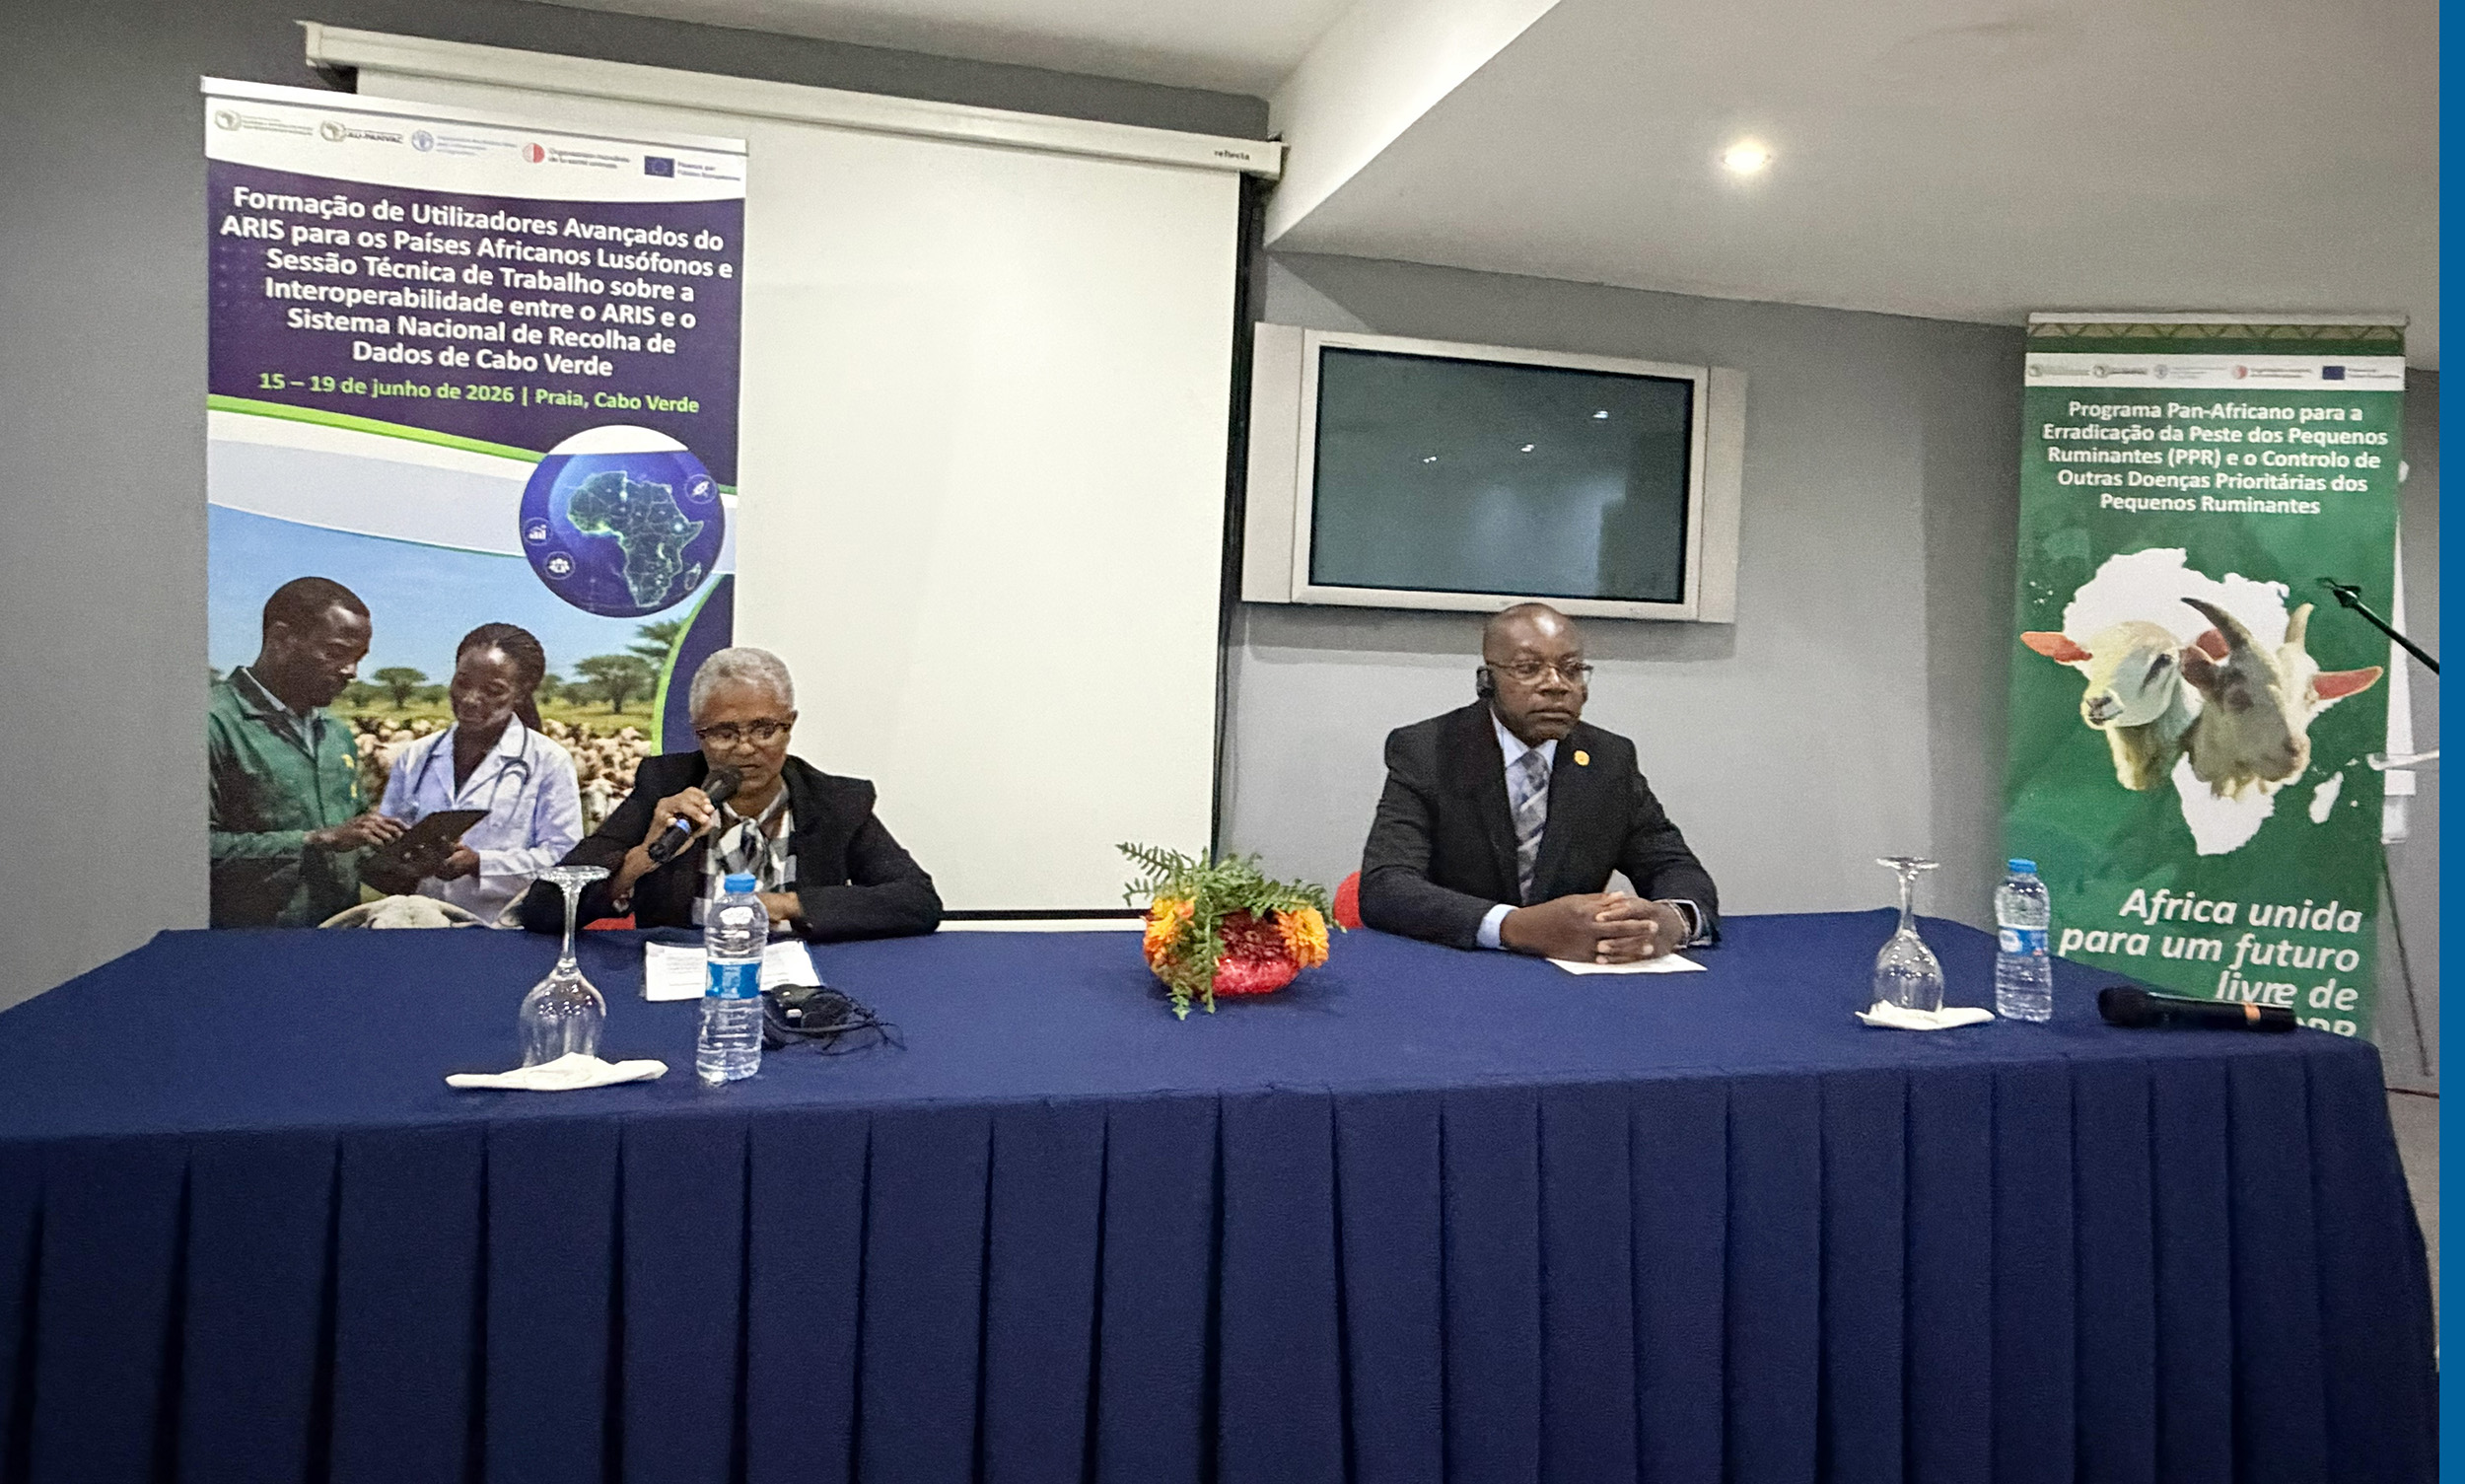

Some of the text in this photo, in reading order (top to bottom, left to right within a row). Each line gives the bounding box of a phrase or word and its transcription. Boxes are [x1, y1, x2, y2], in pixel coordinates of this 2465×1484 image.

[233, 185, 724, 251] Formação de Utilizadores Avançados do
[220, 214, 734, 279] ARIS para os Países Africanos Lusófonos e
[266, 247, 695, 303] Sessão Técnica de Trabalho sobre a
[265, 276, 697, 329] Interoperabilidade entre o ARIS e o
[286, 307, 676, 354] Sistema Nacional de Recolha de
[353, 340, 613, 377] Dados de Cabo Verde
[259, 372, 286, 389] 15
[309, 375, 336, 392] 19
[339, 376, 368, 395] de
[371, 378, 433, 398] junho
[436, 382, 462, 400] de
[464, 384, 516, 403] 2026
[534, 388, 590, 410] Praia,
[593, 391, 642, 410] Cabo
[644, 394, 700, 414] Verde
[2069, 400, 2363, 424] Programa Pan-Africano para a
[2043, 423, 2389, 448] Erradicação da Peste dos Pequenos
[2048, 446, 2381, 469] Ruminantes (PPR) e o Controlo de
[2057, 469, 2368, 492] Outras Doenças Prioritárias dos
[2100, 493, 2321, 515] Pequenos Ruminantes
[2118, 887, 2362, 933] Africa unida
[2057, 928, 2360, 972] para um futuro
[2216, 969, 2359, 1012] livre de
